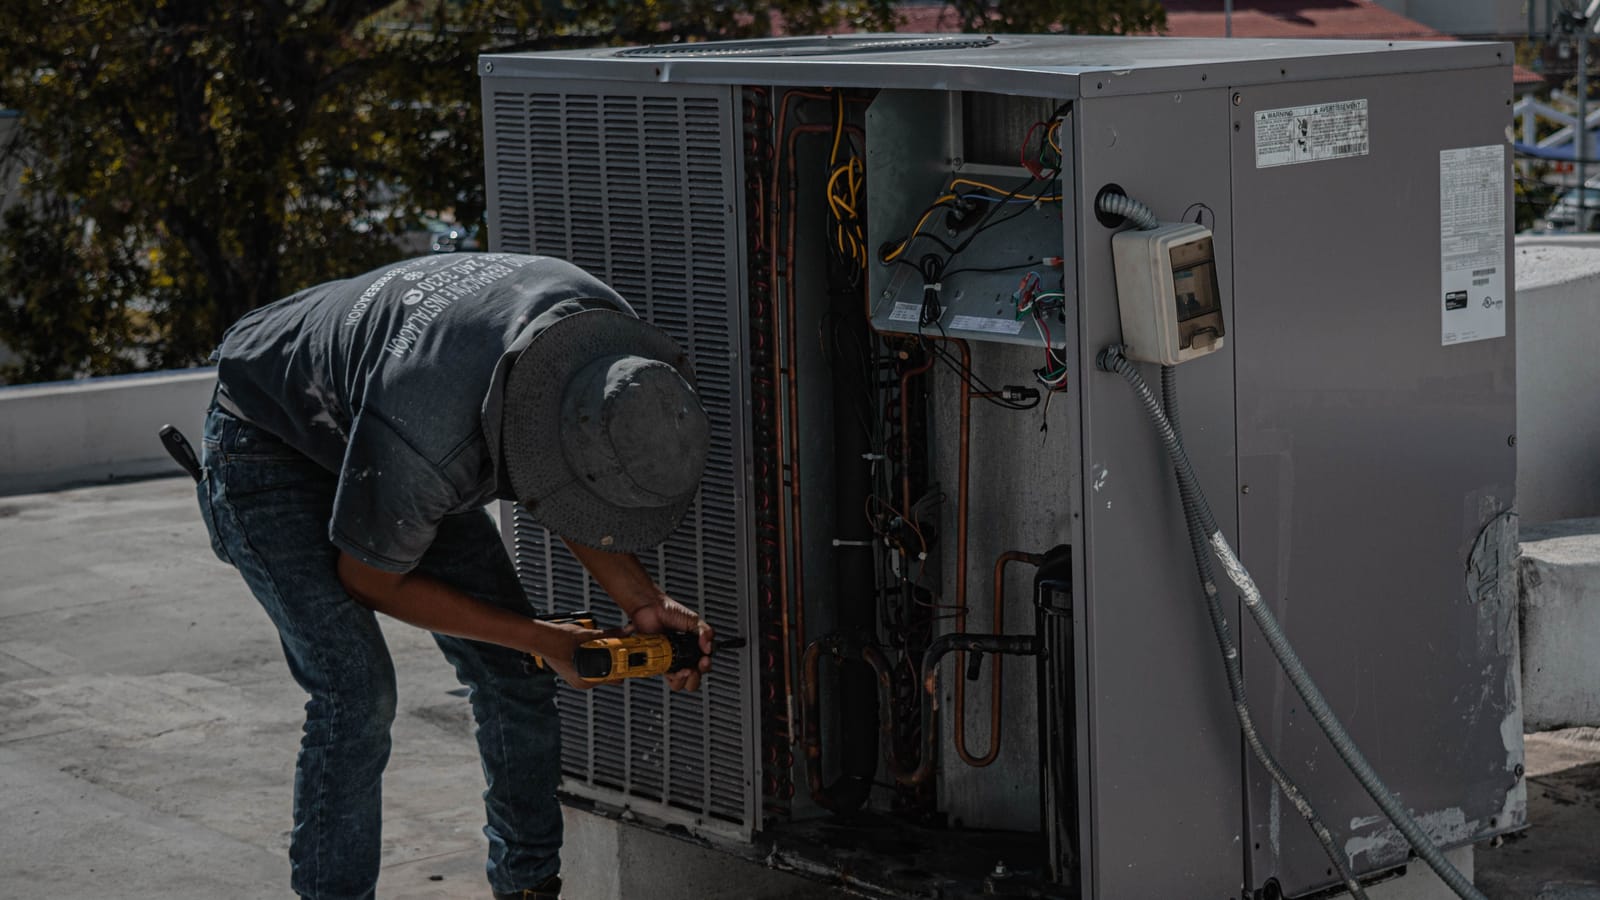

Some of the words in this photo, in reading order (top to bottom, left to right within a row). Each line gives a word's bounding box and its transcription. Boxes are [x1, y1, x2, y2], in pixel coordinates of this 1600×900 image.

[1268, 110, 1294, 119] WARNING
[417, 271, 459, 292] 3230
[385, 293, 452, 357] INSTALACIÓN
